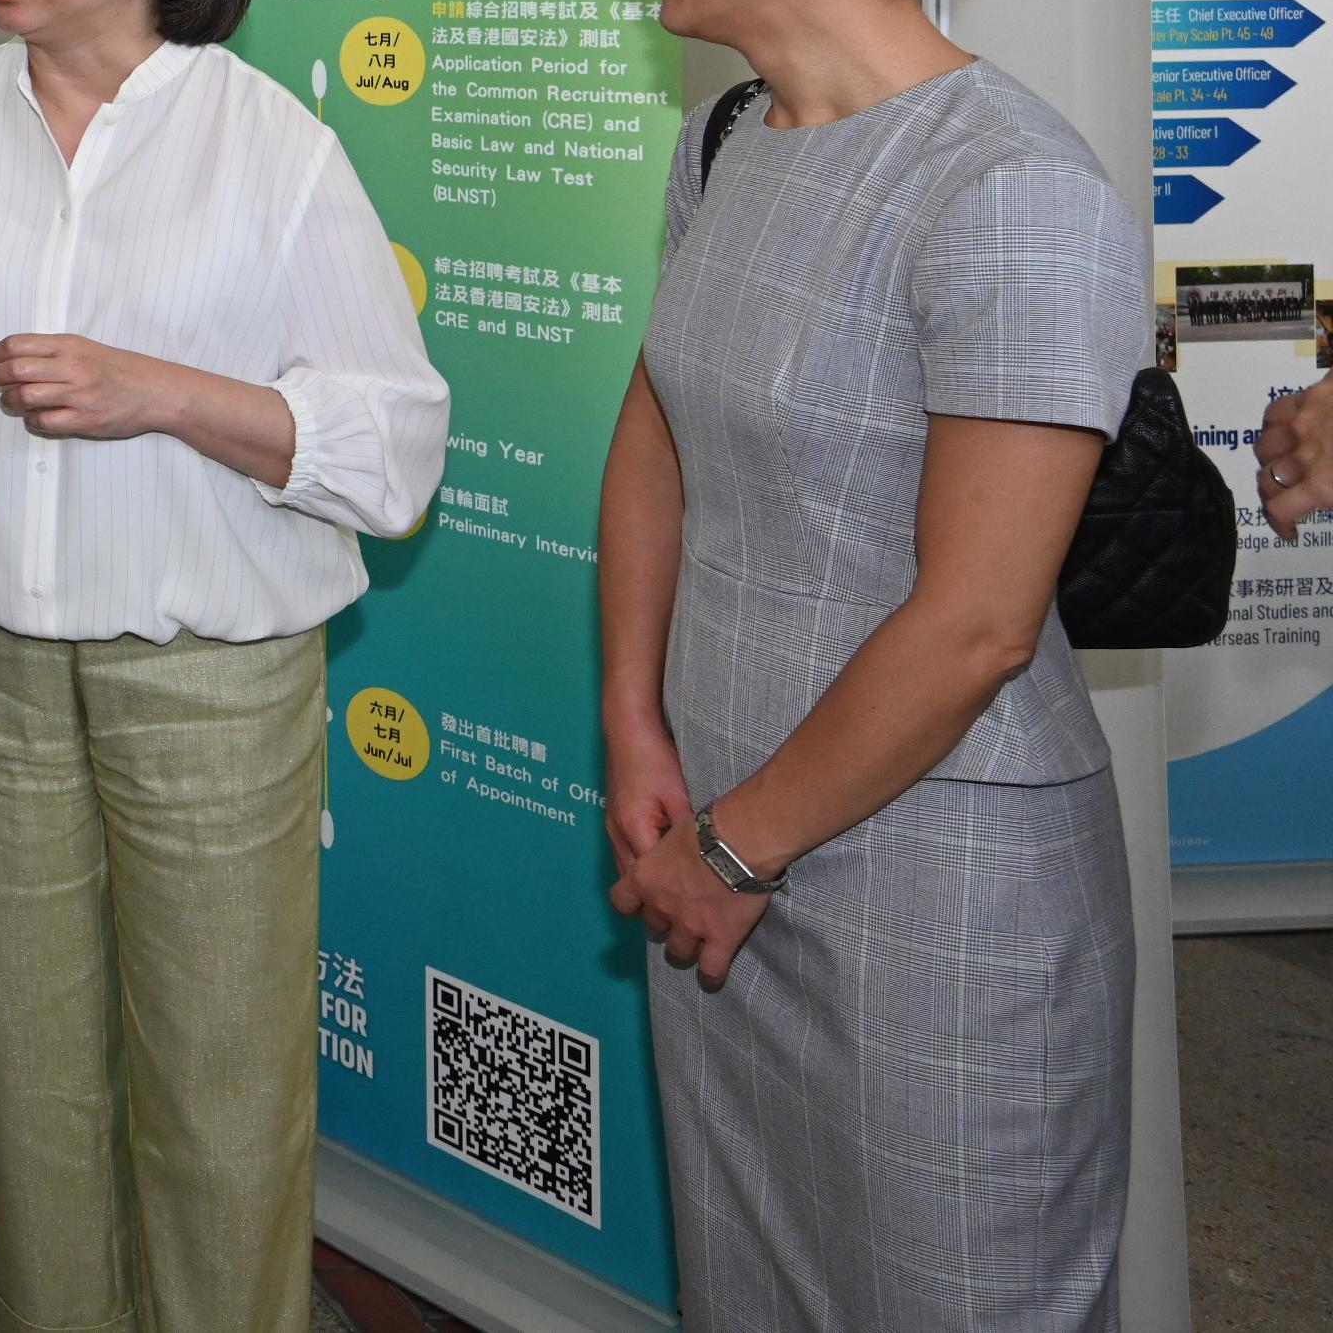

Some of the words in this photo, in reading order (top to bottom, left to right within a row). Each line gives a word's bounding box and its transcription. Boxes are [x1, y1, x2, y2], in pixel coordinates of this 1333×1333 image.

[1189, 9, 1215, 22] Chief
[1218, 8, 1266, 21] Executive
[1269, 7, 1304, 20] Officer
[364, 32, 400, 47] 七月/
[368, 54, 395, 69] 八月
[432, 55, 522, 73] Application
[532, 58, 588, 75] Period
[599, 60, 628, 75] for
[356, 75, 409, 91] Jul/Aug
[432, 82, 457, 97] the
[467, 82, 537, 100] Common
[548, 87, 668, 105] Recruitment
[432, 108, 531, 127] Examination
[543, 111, 592, 133] (CRE)
[604, 117, 639, 132] and
[432, 134, 472, 151] Basic
[481, 136, 514, 153] Law
[524, 141, 554, 155] and
[564, 142, 643, 161] National
[432, 160, 496, 181] Security
[507, 165, 541, 183] Law
[552, 169, 593, 186] Test
[433, 186, 496, 207] (BLNST)
[435, 311, 468, 329] CRE
[478, 320, 506, 335] and
[516, 323, 574, 344] BLNST
[498, 440, 544, 465] Year
[439, 486, 508, 516] 首輪面試
[439, 513, 526, 548] Preliminary
[370, 701, 405, 723] 六月/
[373, 725, 400, 744] 七月
[441, 712, 547, 763] 發出首批聘書
[364, 742, 412, 768] Jun/Jul
[441, 740, 476, 765] First
[485, 755, 531, 784] Batch
[542, 777, 559, 792] of
[441, 770, 457, 784] of
[467, 777, 575, 826] Appointment
[322, 990, 367, 1037] FOR
